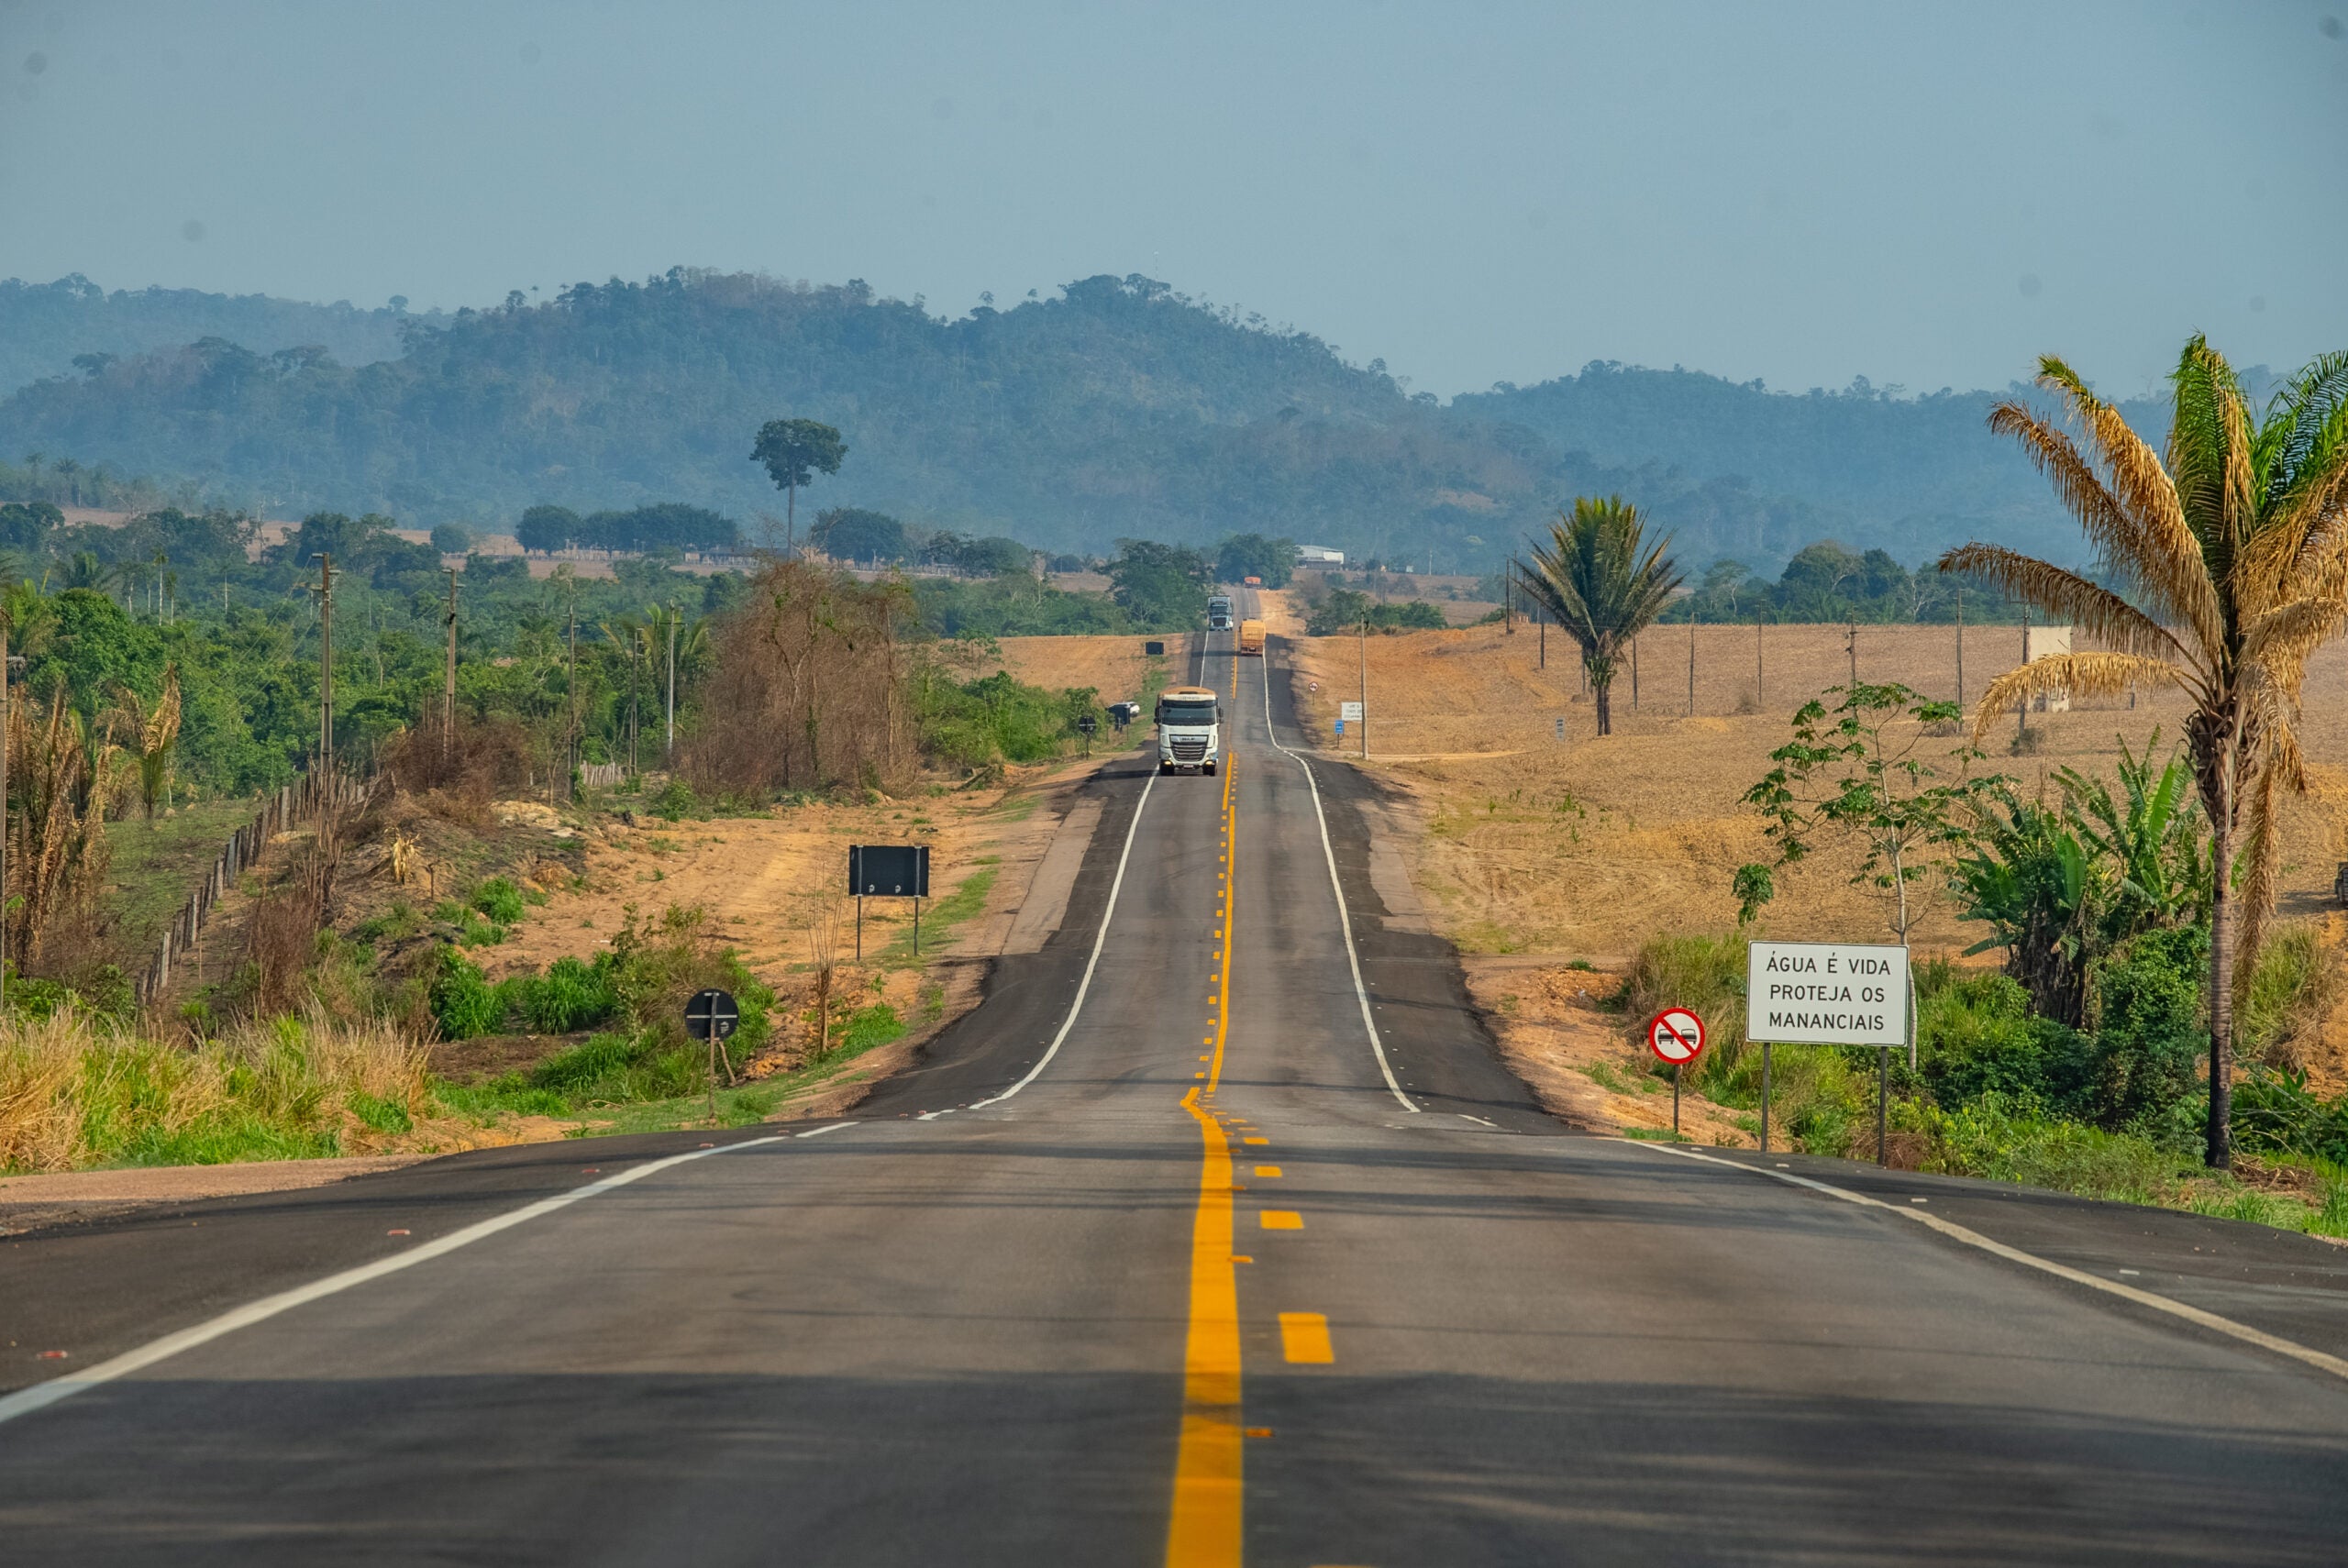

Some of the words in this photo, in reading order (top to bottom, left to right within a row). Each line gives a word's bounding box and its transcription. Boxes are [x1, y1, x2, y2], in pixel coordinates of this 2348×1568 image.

[1766, 951, 1817, 973] ÁGUA
[1827, 952, 1838, 974] É
[1848, 958, 1891, 975] VIDA
[1769, 984, 1852, 1001] PROTEJA
[1862, 987, 1885, 1002] OS
[1769, 1011, 1884, 1031] MANANCIAIS
